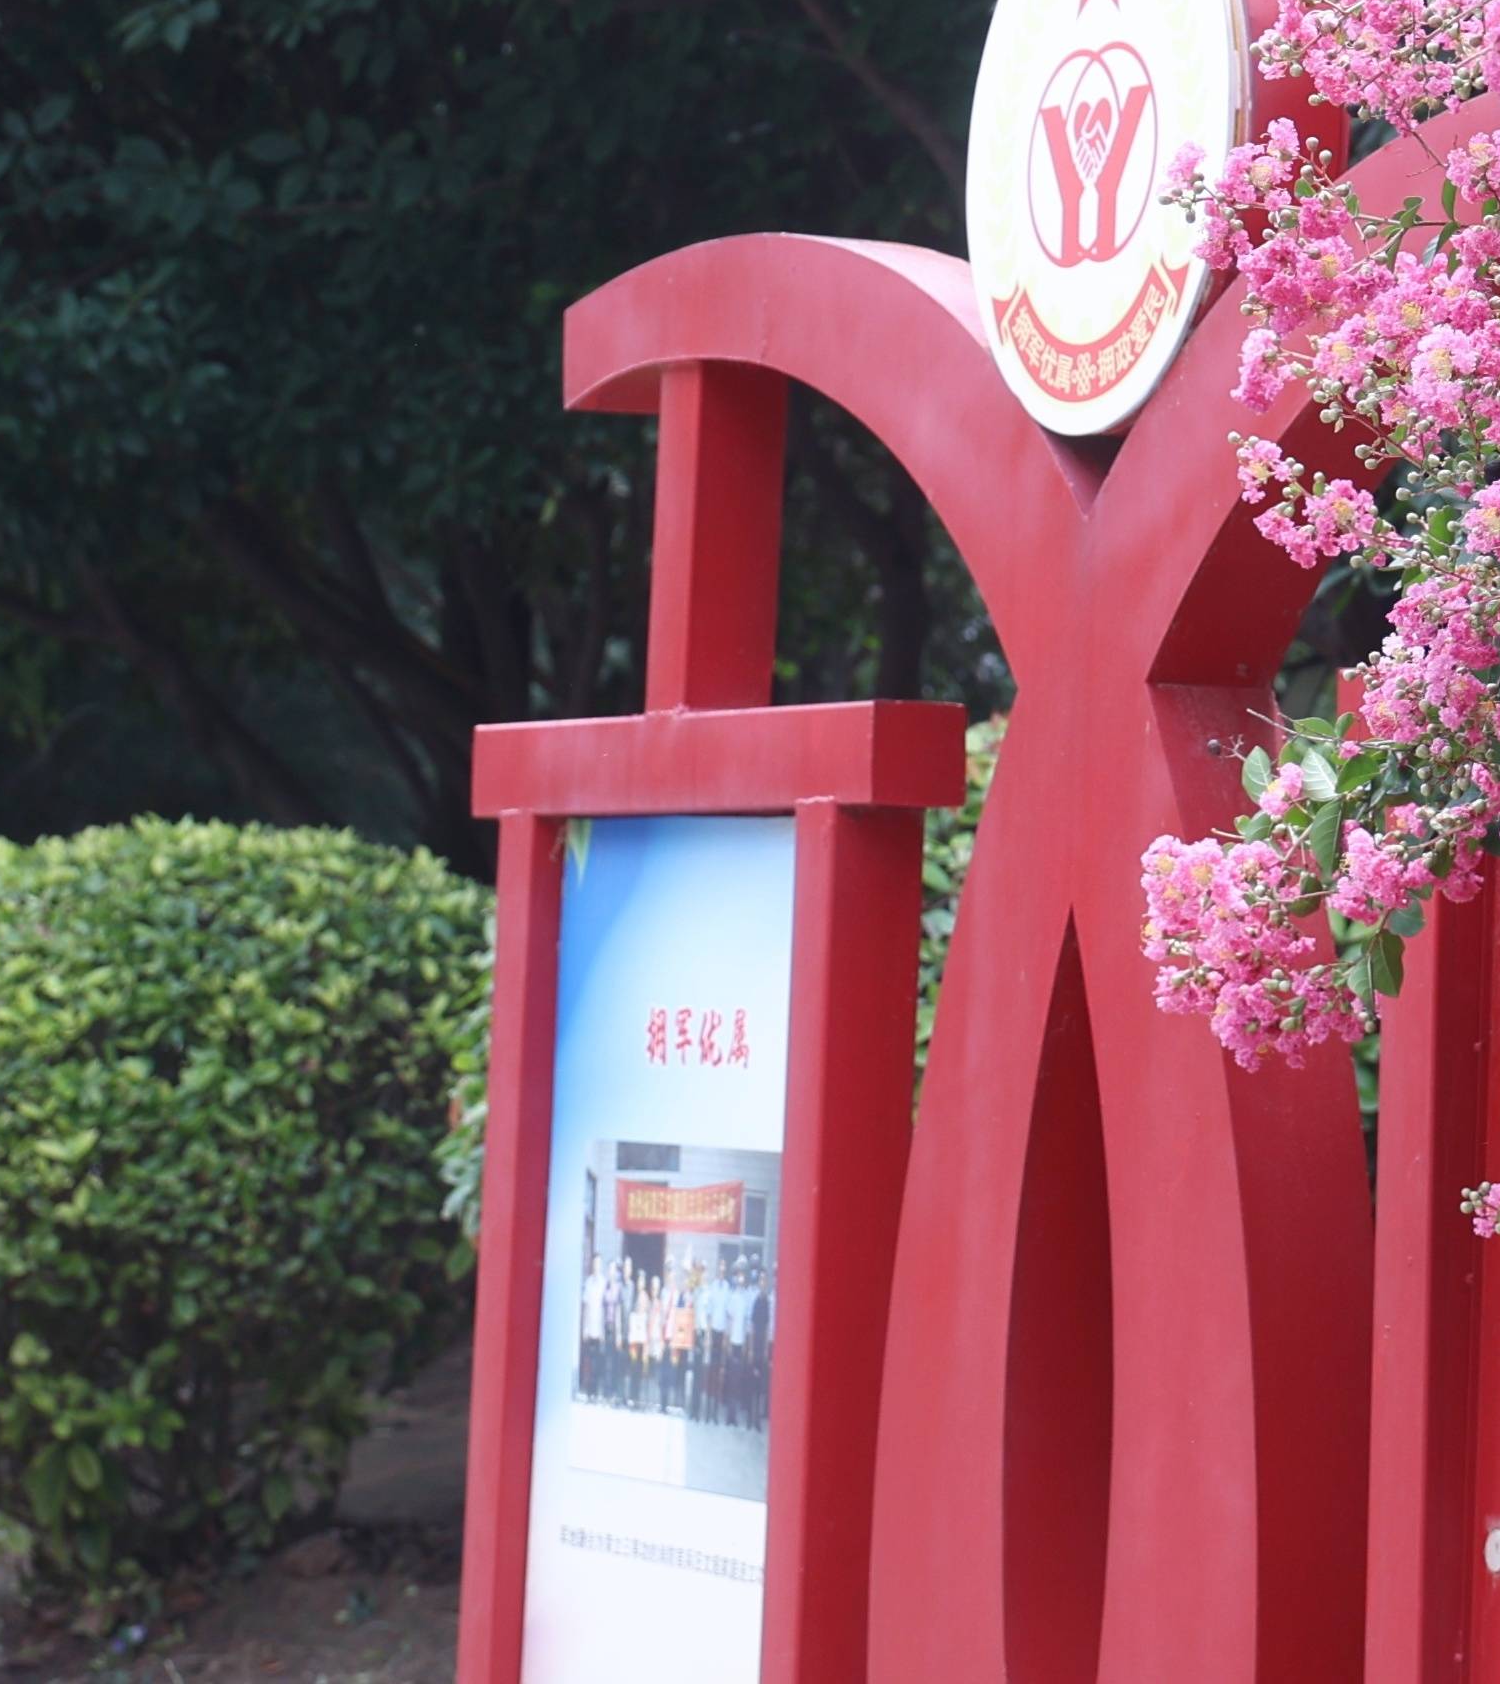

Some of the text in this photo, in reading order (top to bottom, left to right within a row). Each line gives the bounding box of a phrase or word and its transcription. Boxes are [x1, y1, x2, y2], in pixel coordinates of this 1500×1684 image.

[1011, 284, 1165, 394] 拥军优属 拥政爱民
